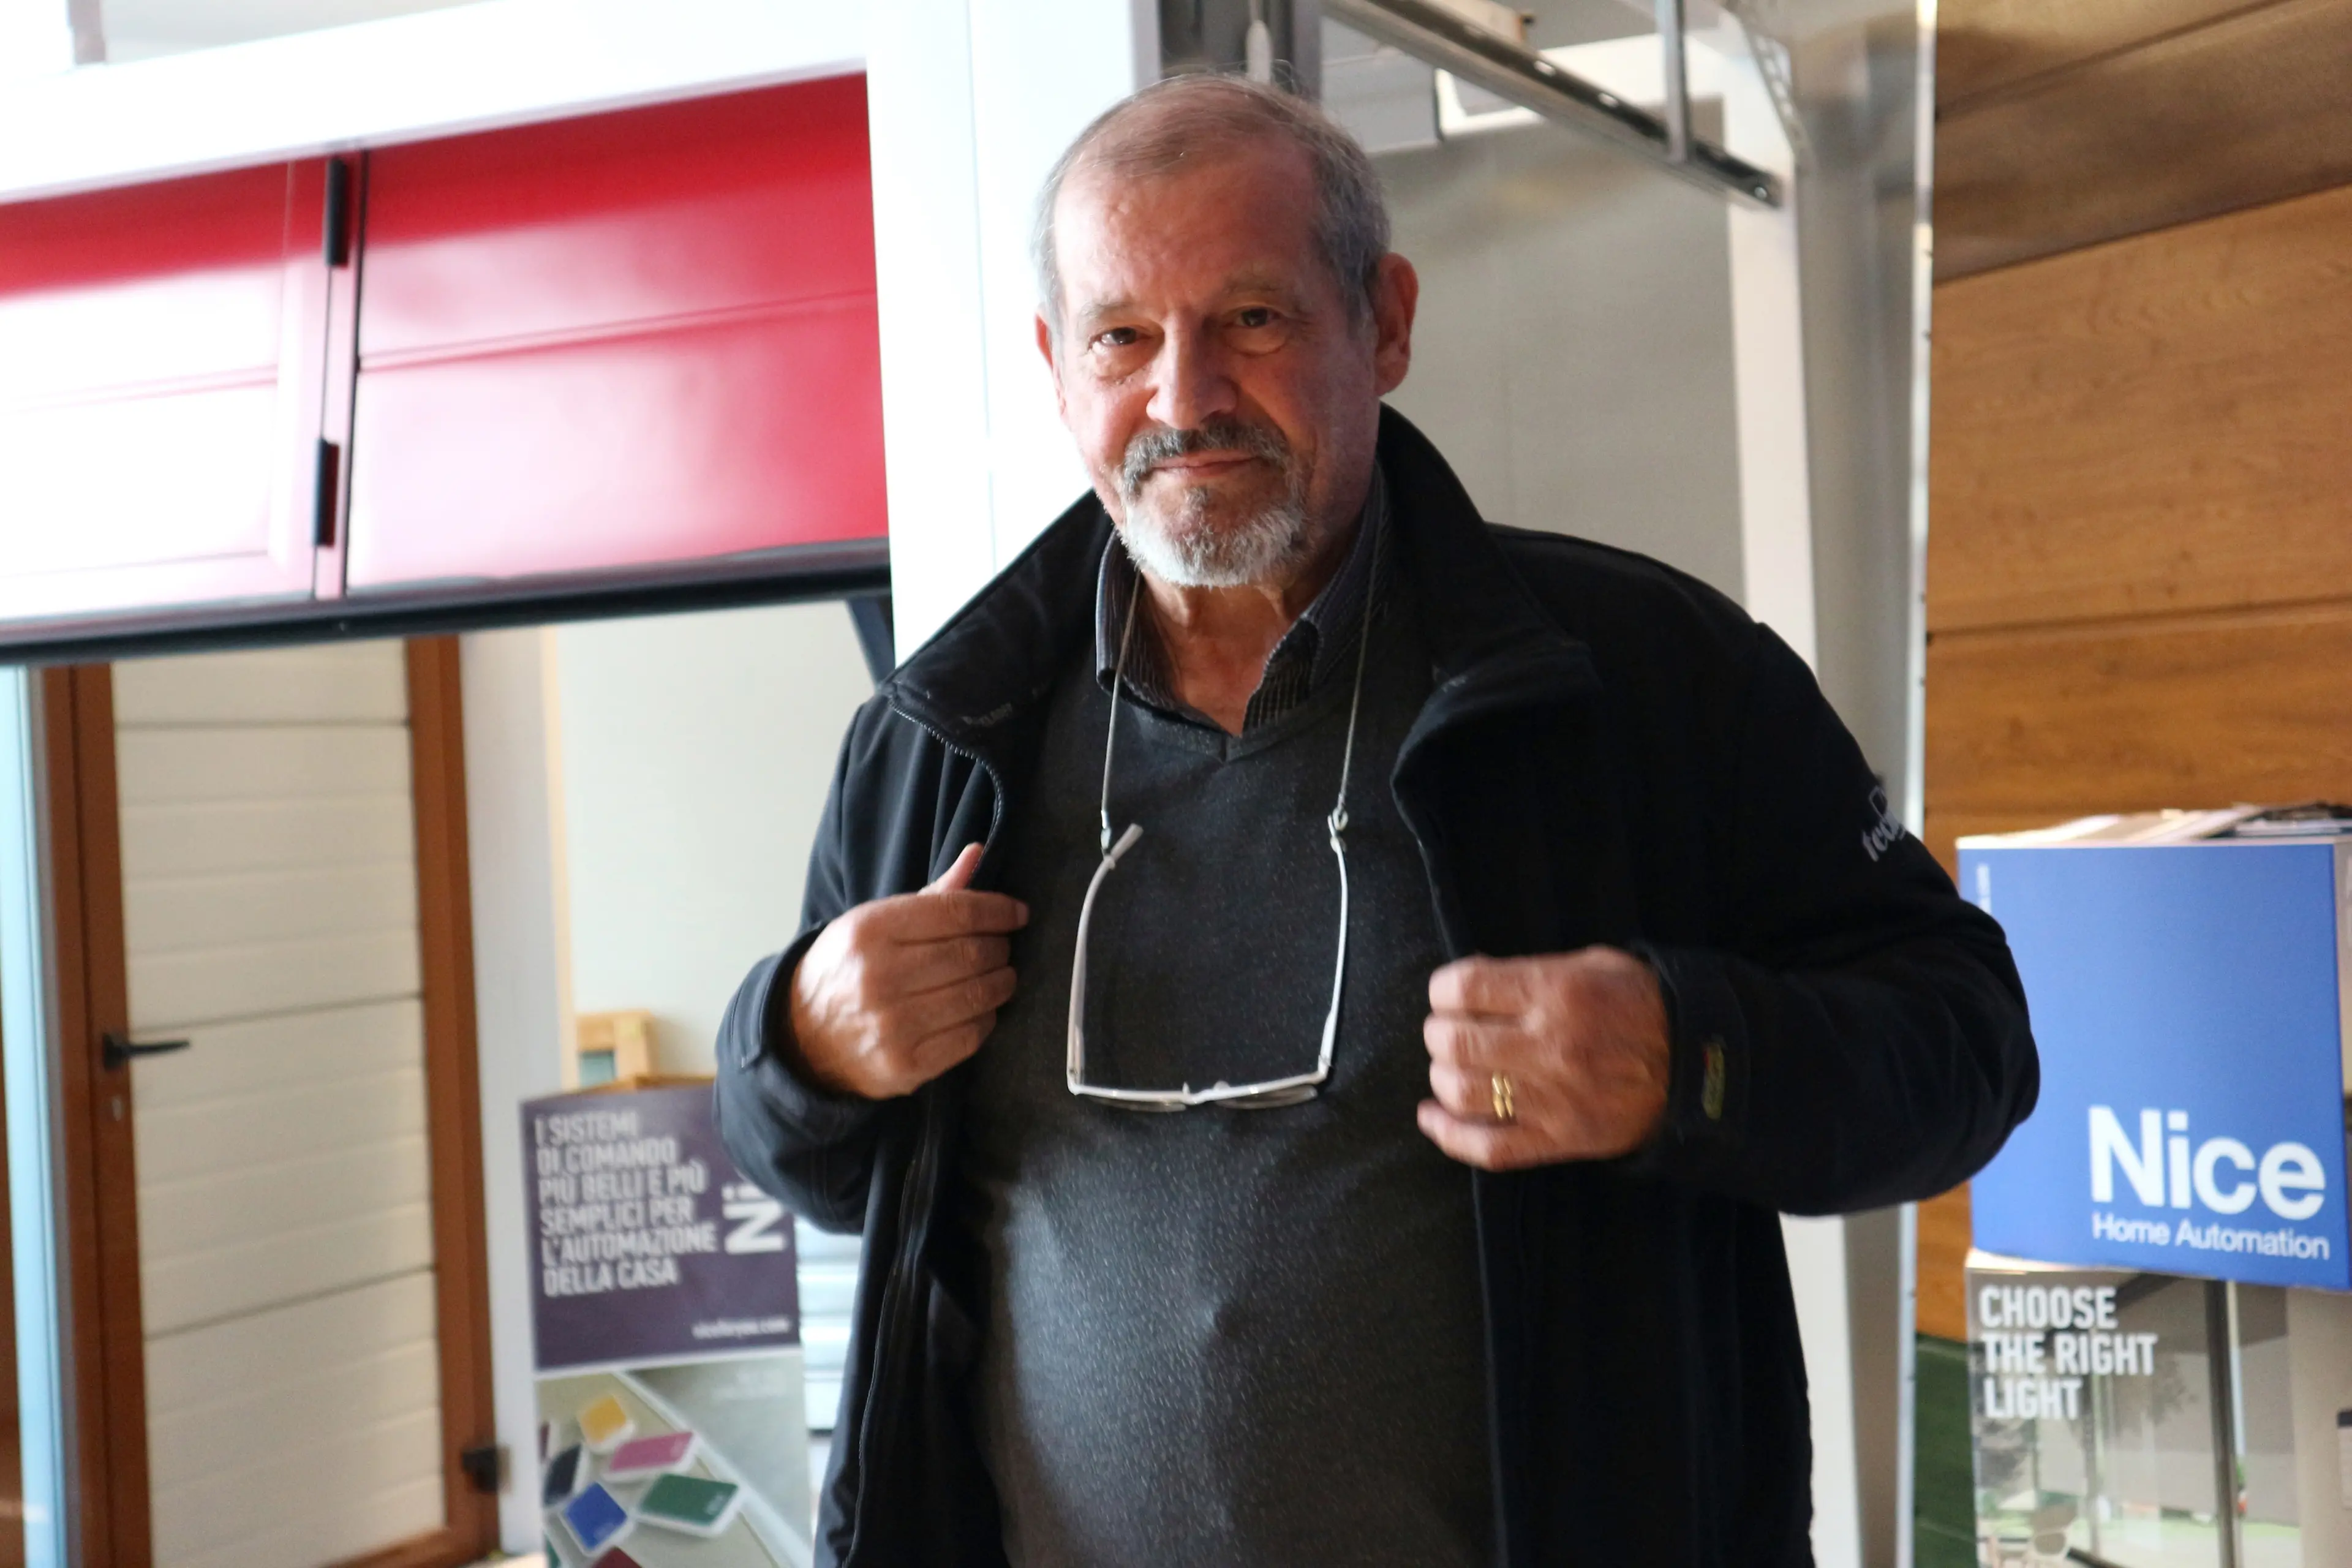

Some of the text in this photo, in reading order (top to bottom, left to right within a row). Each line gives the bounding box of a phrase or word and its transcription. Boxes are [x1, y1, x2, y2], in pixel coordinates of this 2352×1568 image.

[534, 1111, 638, 1147] I SISTEMI
[537, 1137, 677, 1175] DI COMANDO
[2088, 1104, 2326, 1220] Nice
[581, 1170, 643, 1202] BELLI
[648, 1167, 662, 1196] E
[540, 1196, 694, 1237] SEMPLICI PER
[2092, 1212, 2331, 1261] Home Automation
[543, 1257, 680, 1297] DELLA CASA
[1978, 1285, 2119, 1329] CHOOSE
[1980, 1332, 2158, 1376] THE RIGHT
[1983, 1378, 2082, 1420] LIGHT
